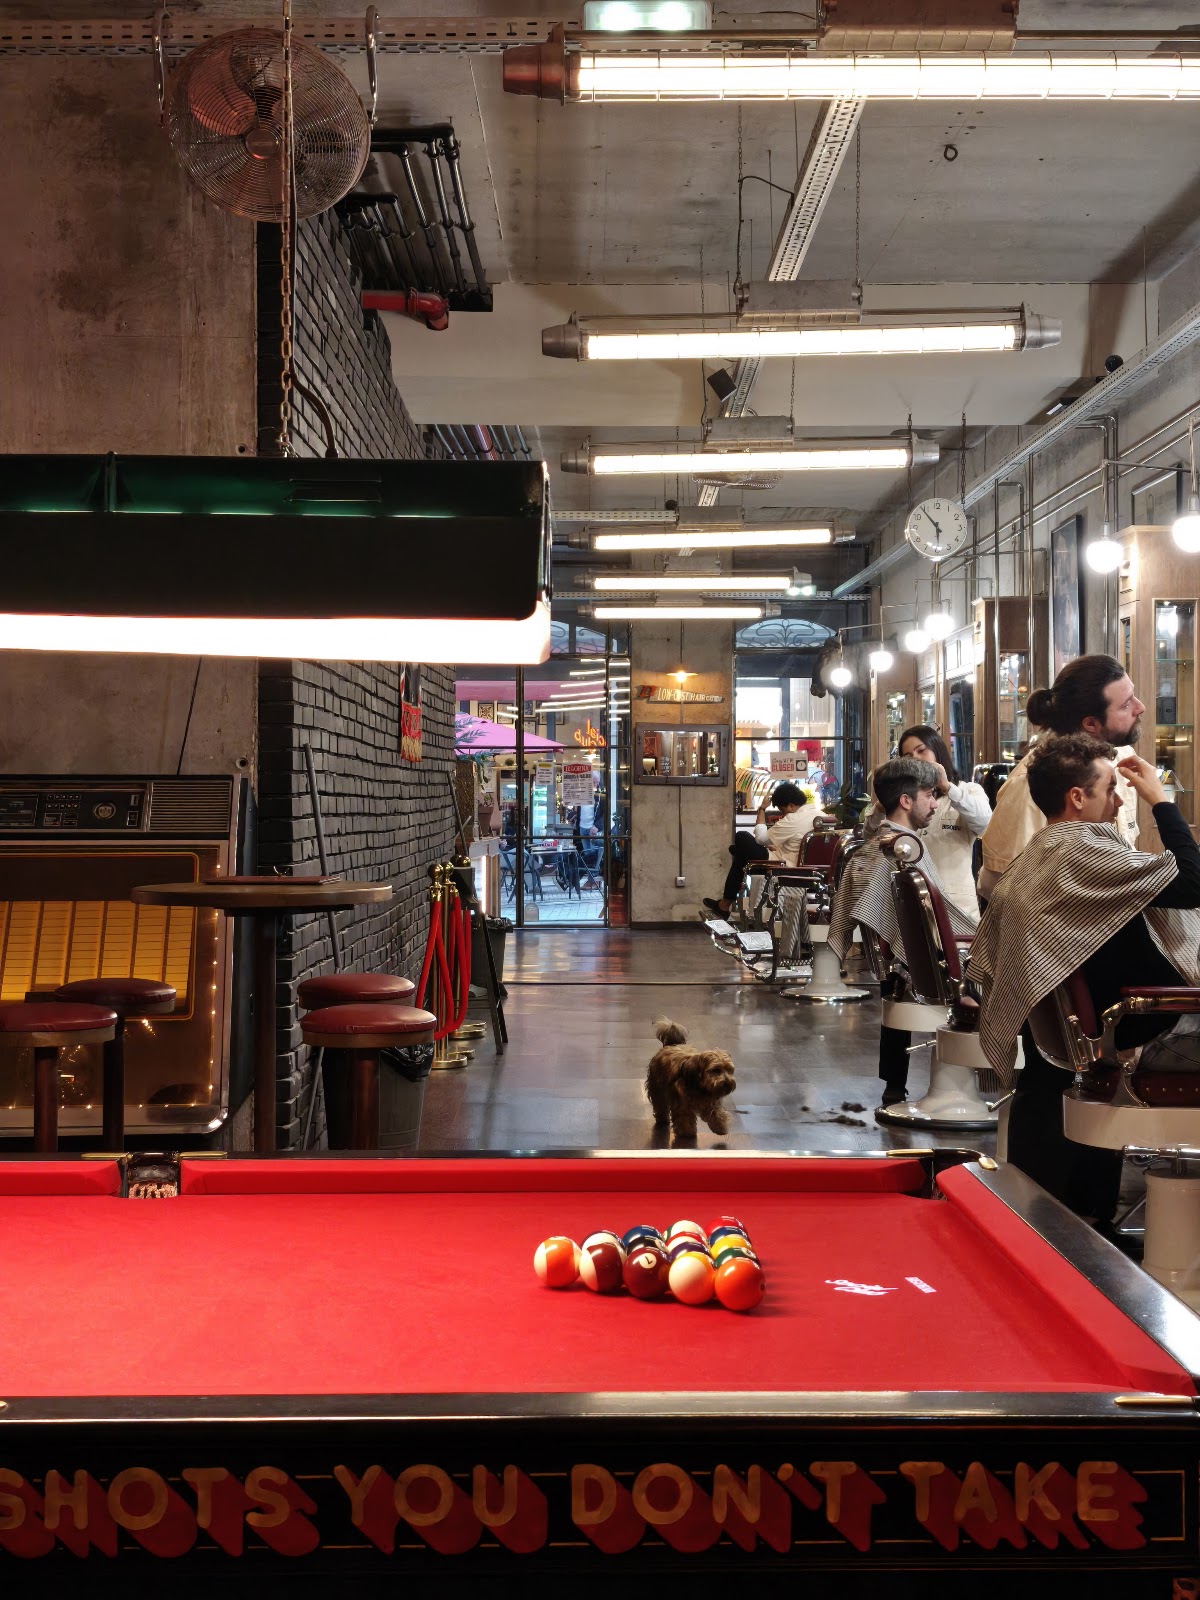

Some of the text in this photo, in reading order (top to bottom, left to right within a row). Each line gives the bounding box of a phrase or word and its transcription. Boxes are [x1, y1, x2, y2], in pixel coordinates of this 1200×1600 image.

[0, 1461, 1119, 1531] SHOTS YOU DON'T TAKE
